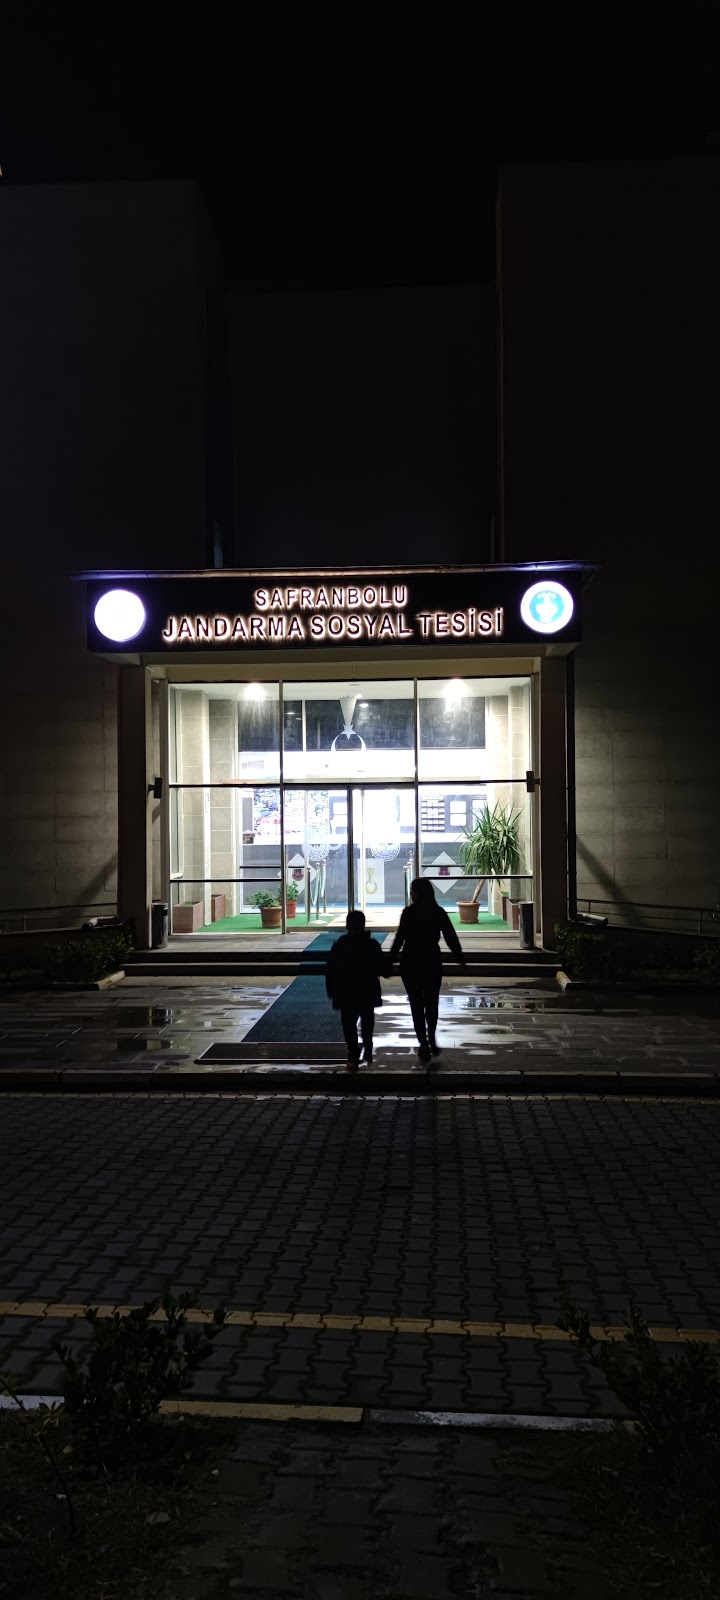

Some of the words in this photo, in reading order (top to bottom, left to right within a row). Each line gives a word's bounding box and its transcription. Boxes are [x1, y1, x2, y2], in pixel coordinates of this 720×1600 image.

[254, 586, 408, 608] SAFRANBOLU
[163, 615, 303, 639] JANDARMA
[311, 613, 413, 637] SOSYAL
[419, 608, 504, 636] TESİSİ
